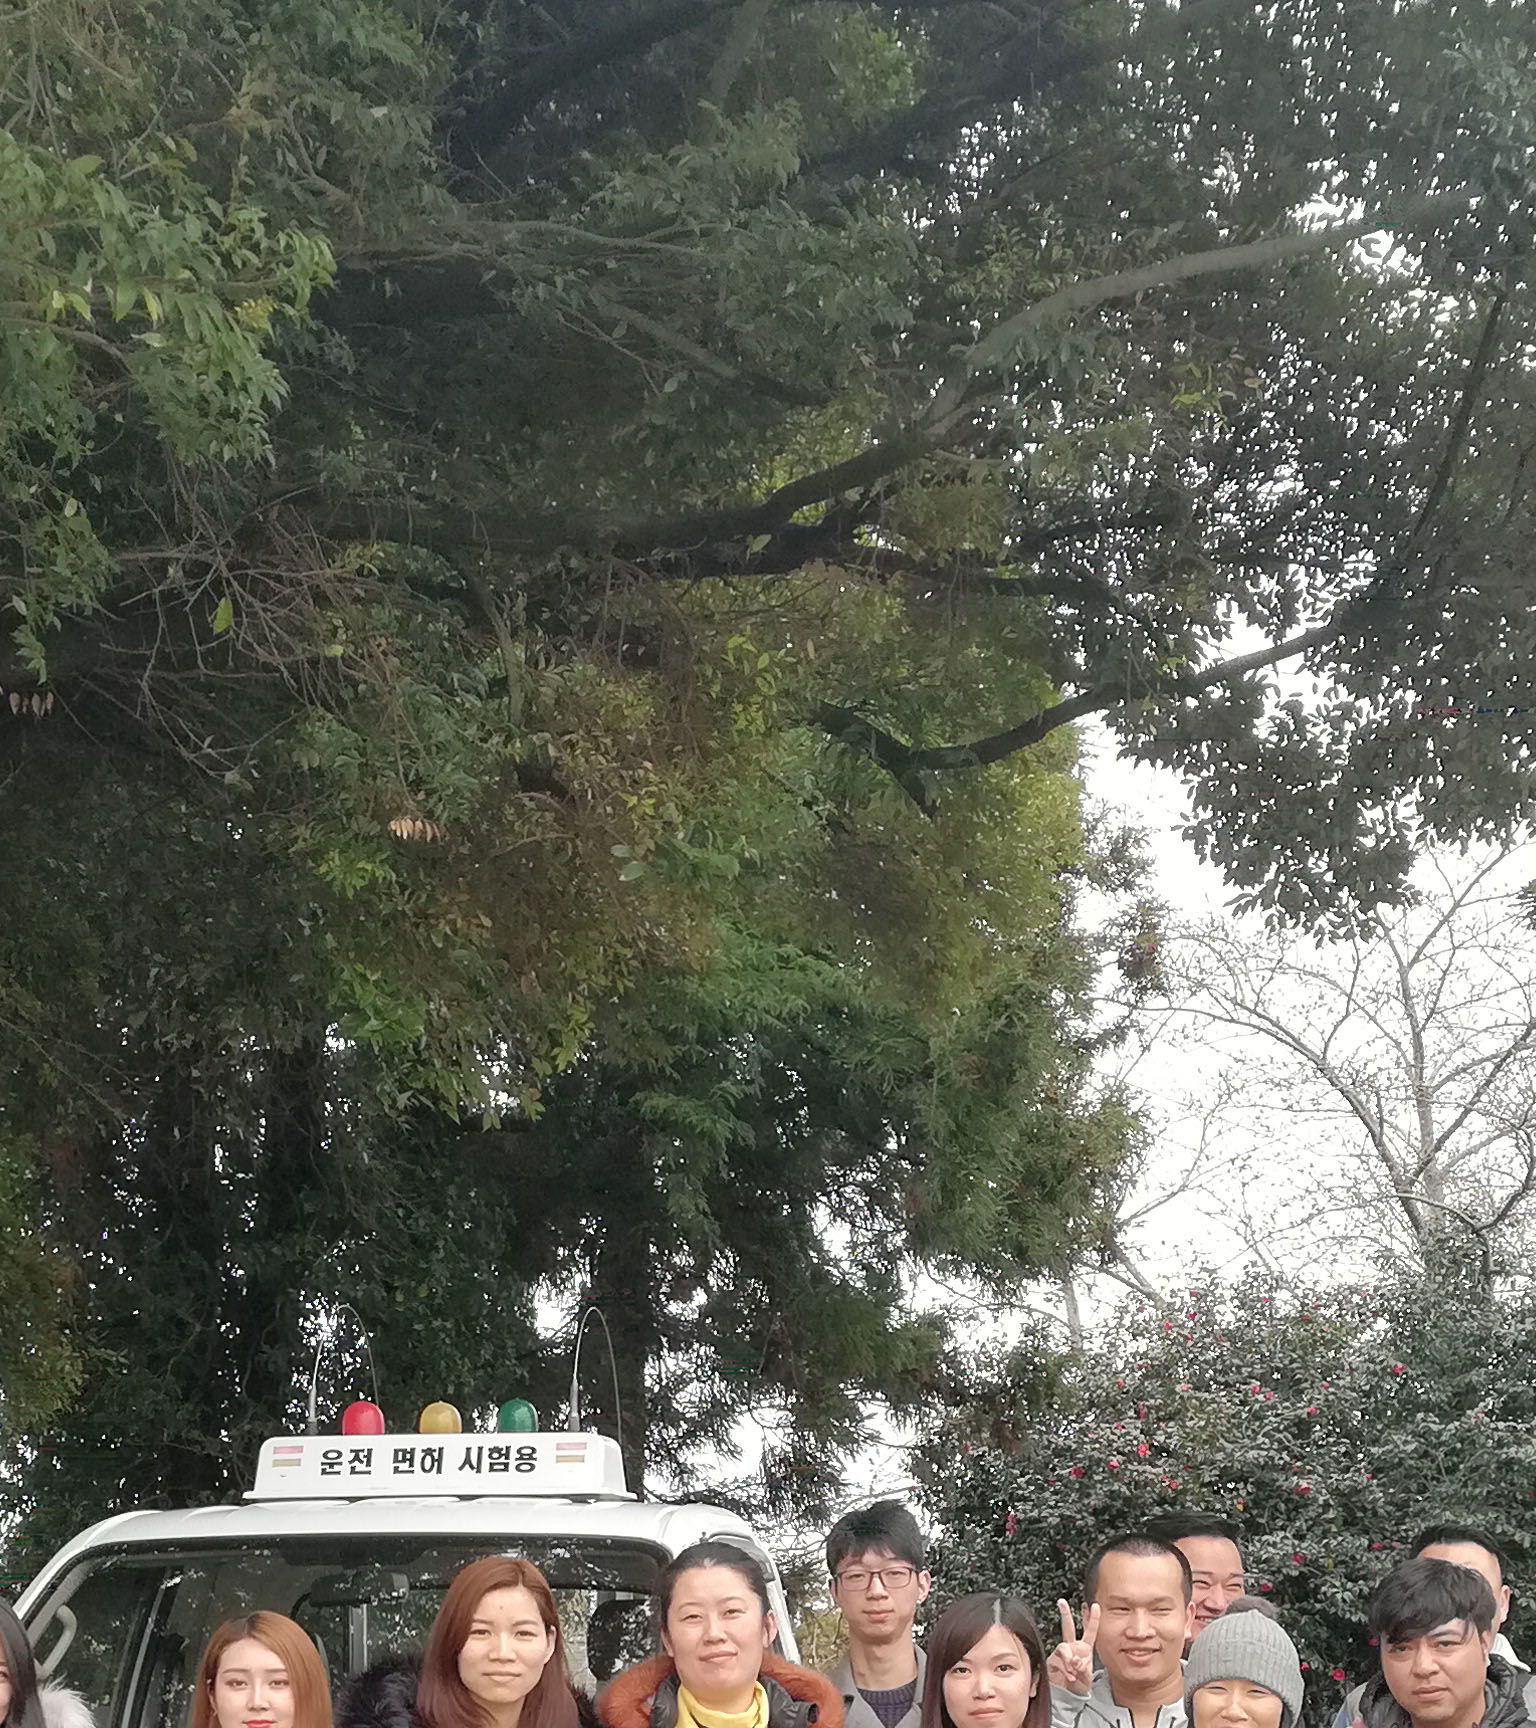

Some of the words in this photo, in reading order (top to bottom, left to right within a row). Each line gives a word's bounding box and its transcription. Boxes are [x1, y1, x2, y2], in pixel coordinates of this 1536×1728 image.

[320, 1448, 373, 1476] 운전
[392, 1446, 445, 1475] 면허
[458, 1445, 539, 1474] 시험용
